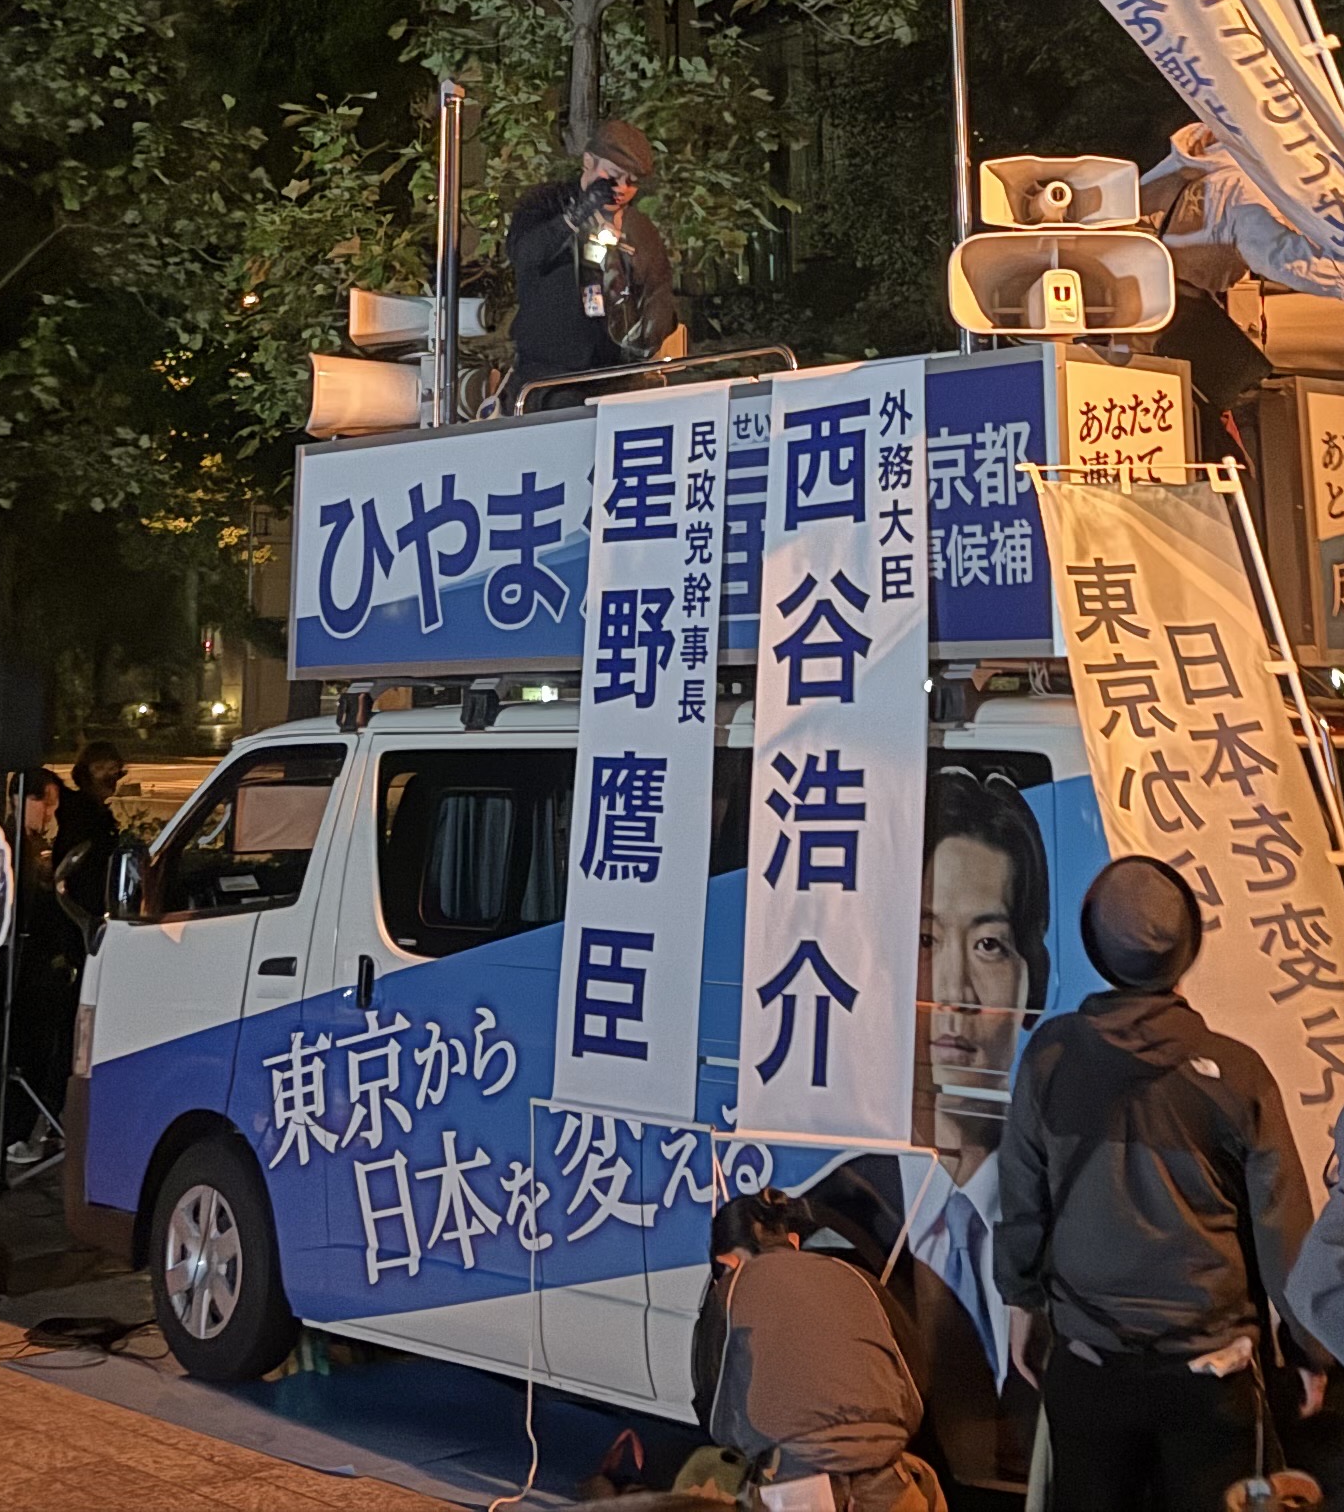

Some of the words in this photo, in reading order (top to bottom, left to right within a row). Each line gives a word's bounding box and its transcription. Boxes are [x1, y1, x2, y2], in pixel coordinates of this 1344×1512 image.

[878, 388, 915, 603] 外務大臣
[1078, 389, 1174, 445] あなたを
[317, 471, 601, 640] ひやま
[678, 420, 717, 726] 民政党幹事長
[572, 424, 678, 1061] 星野鷹臣
[755, 398, 873, 1088] 西谷浩介
[261, 1007, 518, 1172] 東京から
[352, 1104, 774, 1285] 日本を変える
